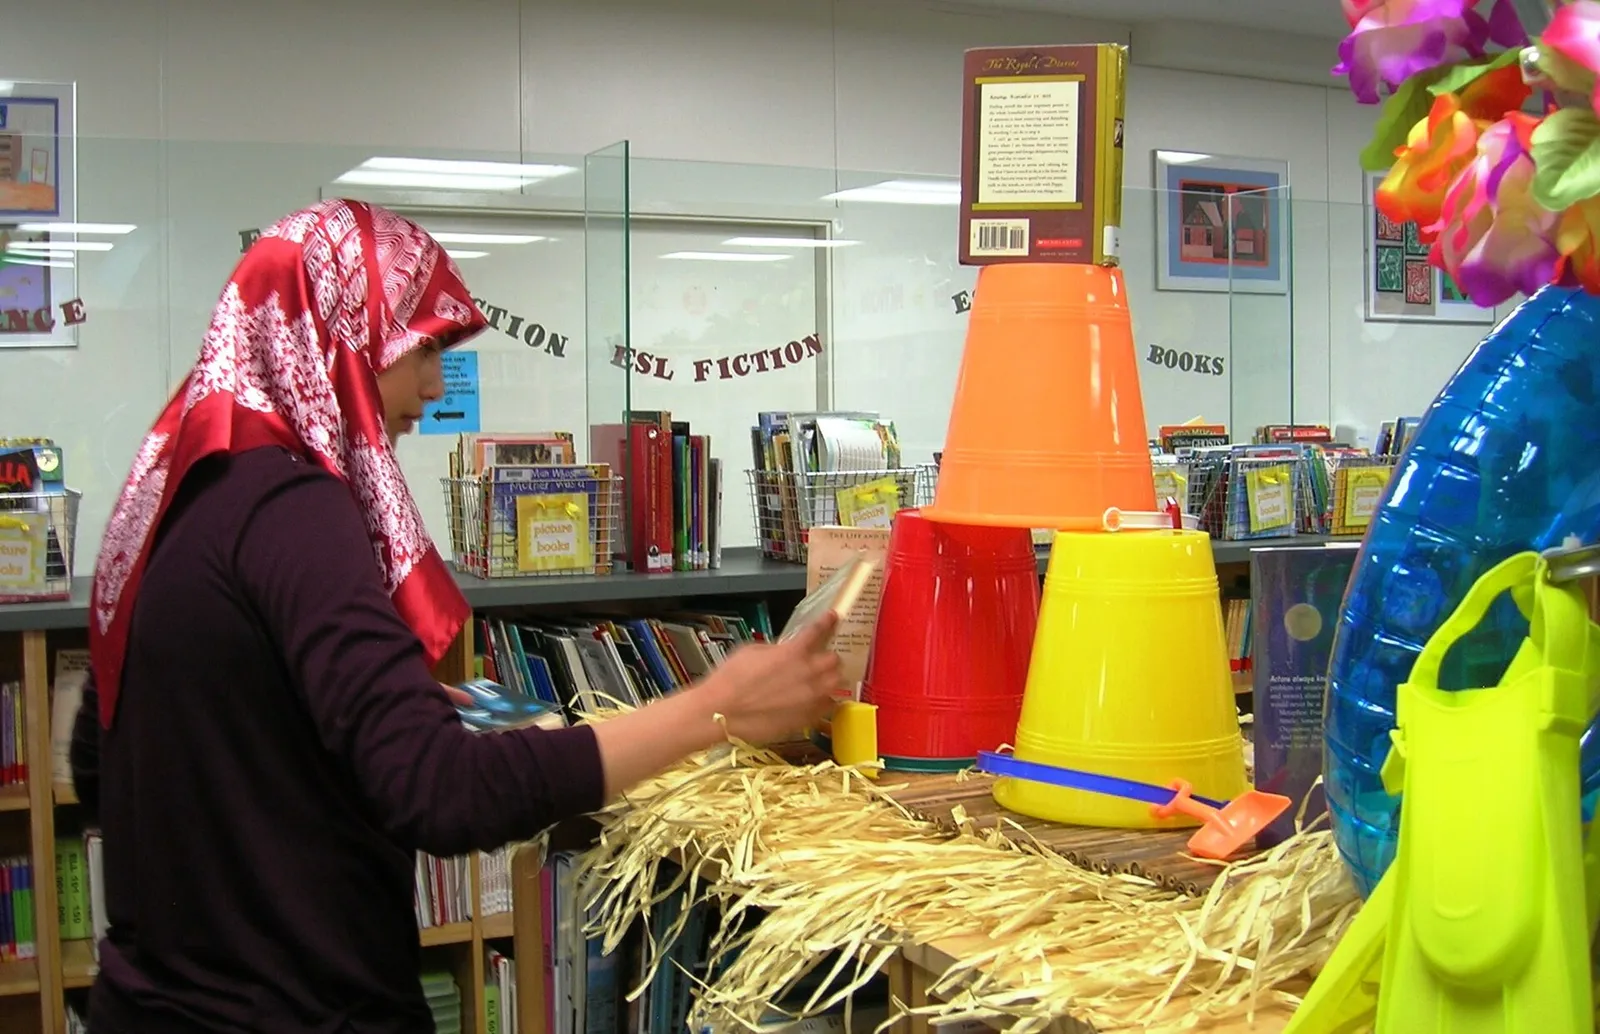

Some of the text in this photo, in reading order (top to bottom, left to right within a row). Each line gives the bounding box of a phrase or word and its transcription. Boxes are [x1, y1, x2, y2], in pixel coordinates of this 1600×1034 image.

[0, 297, 87, 333] NCE
[610, 333, 823, 382] ESL FICTION
[1147, 344, 1225, 376] BOOKS
[534, 523, 573, 538] picture
[537, 539, 570, 553] books
